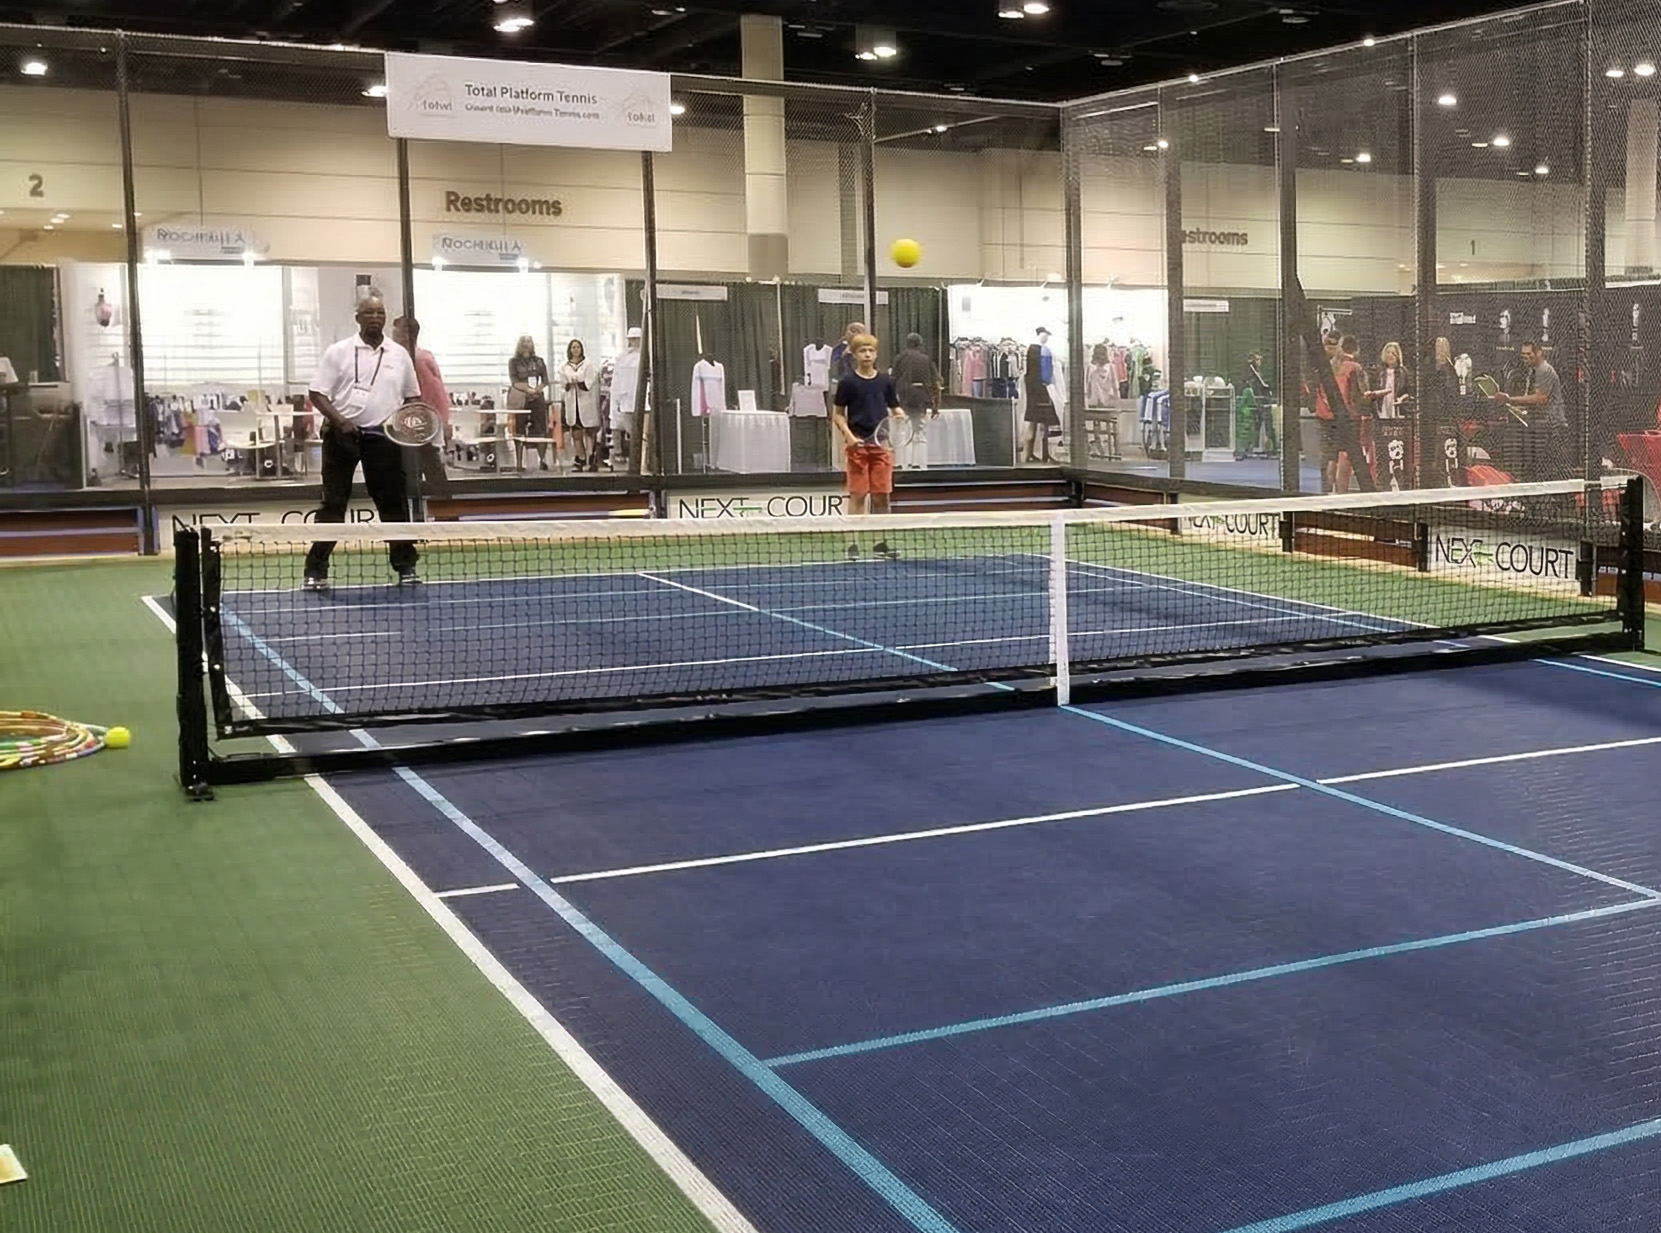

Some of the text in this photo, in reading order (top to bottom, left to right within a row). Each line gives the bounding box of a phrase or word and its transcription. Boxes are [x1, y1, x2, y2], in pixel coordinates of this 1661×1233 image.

[464, 84, 598, 105] Total Platform Tennis
[29, 173, 44, 198] 2
[445, 191, 562, 217] Restrooms
[1181, 228, 1248, 246] strooms
[678, 495, 850, 519] NEXT COUR
[1225, 513, 1281, 539] COURT
[1496, 542, 1574, 579] COURT
